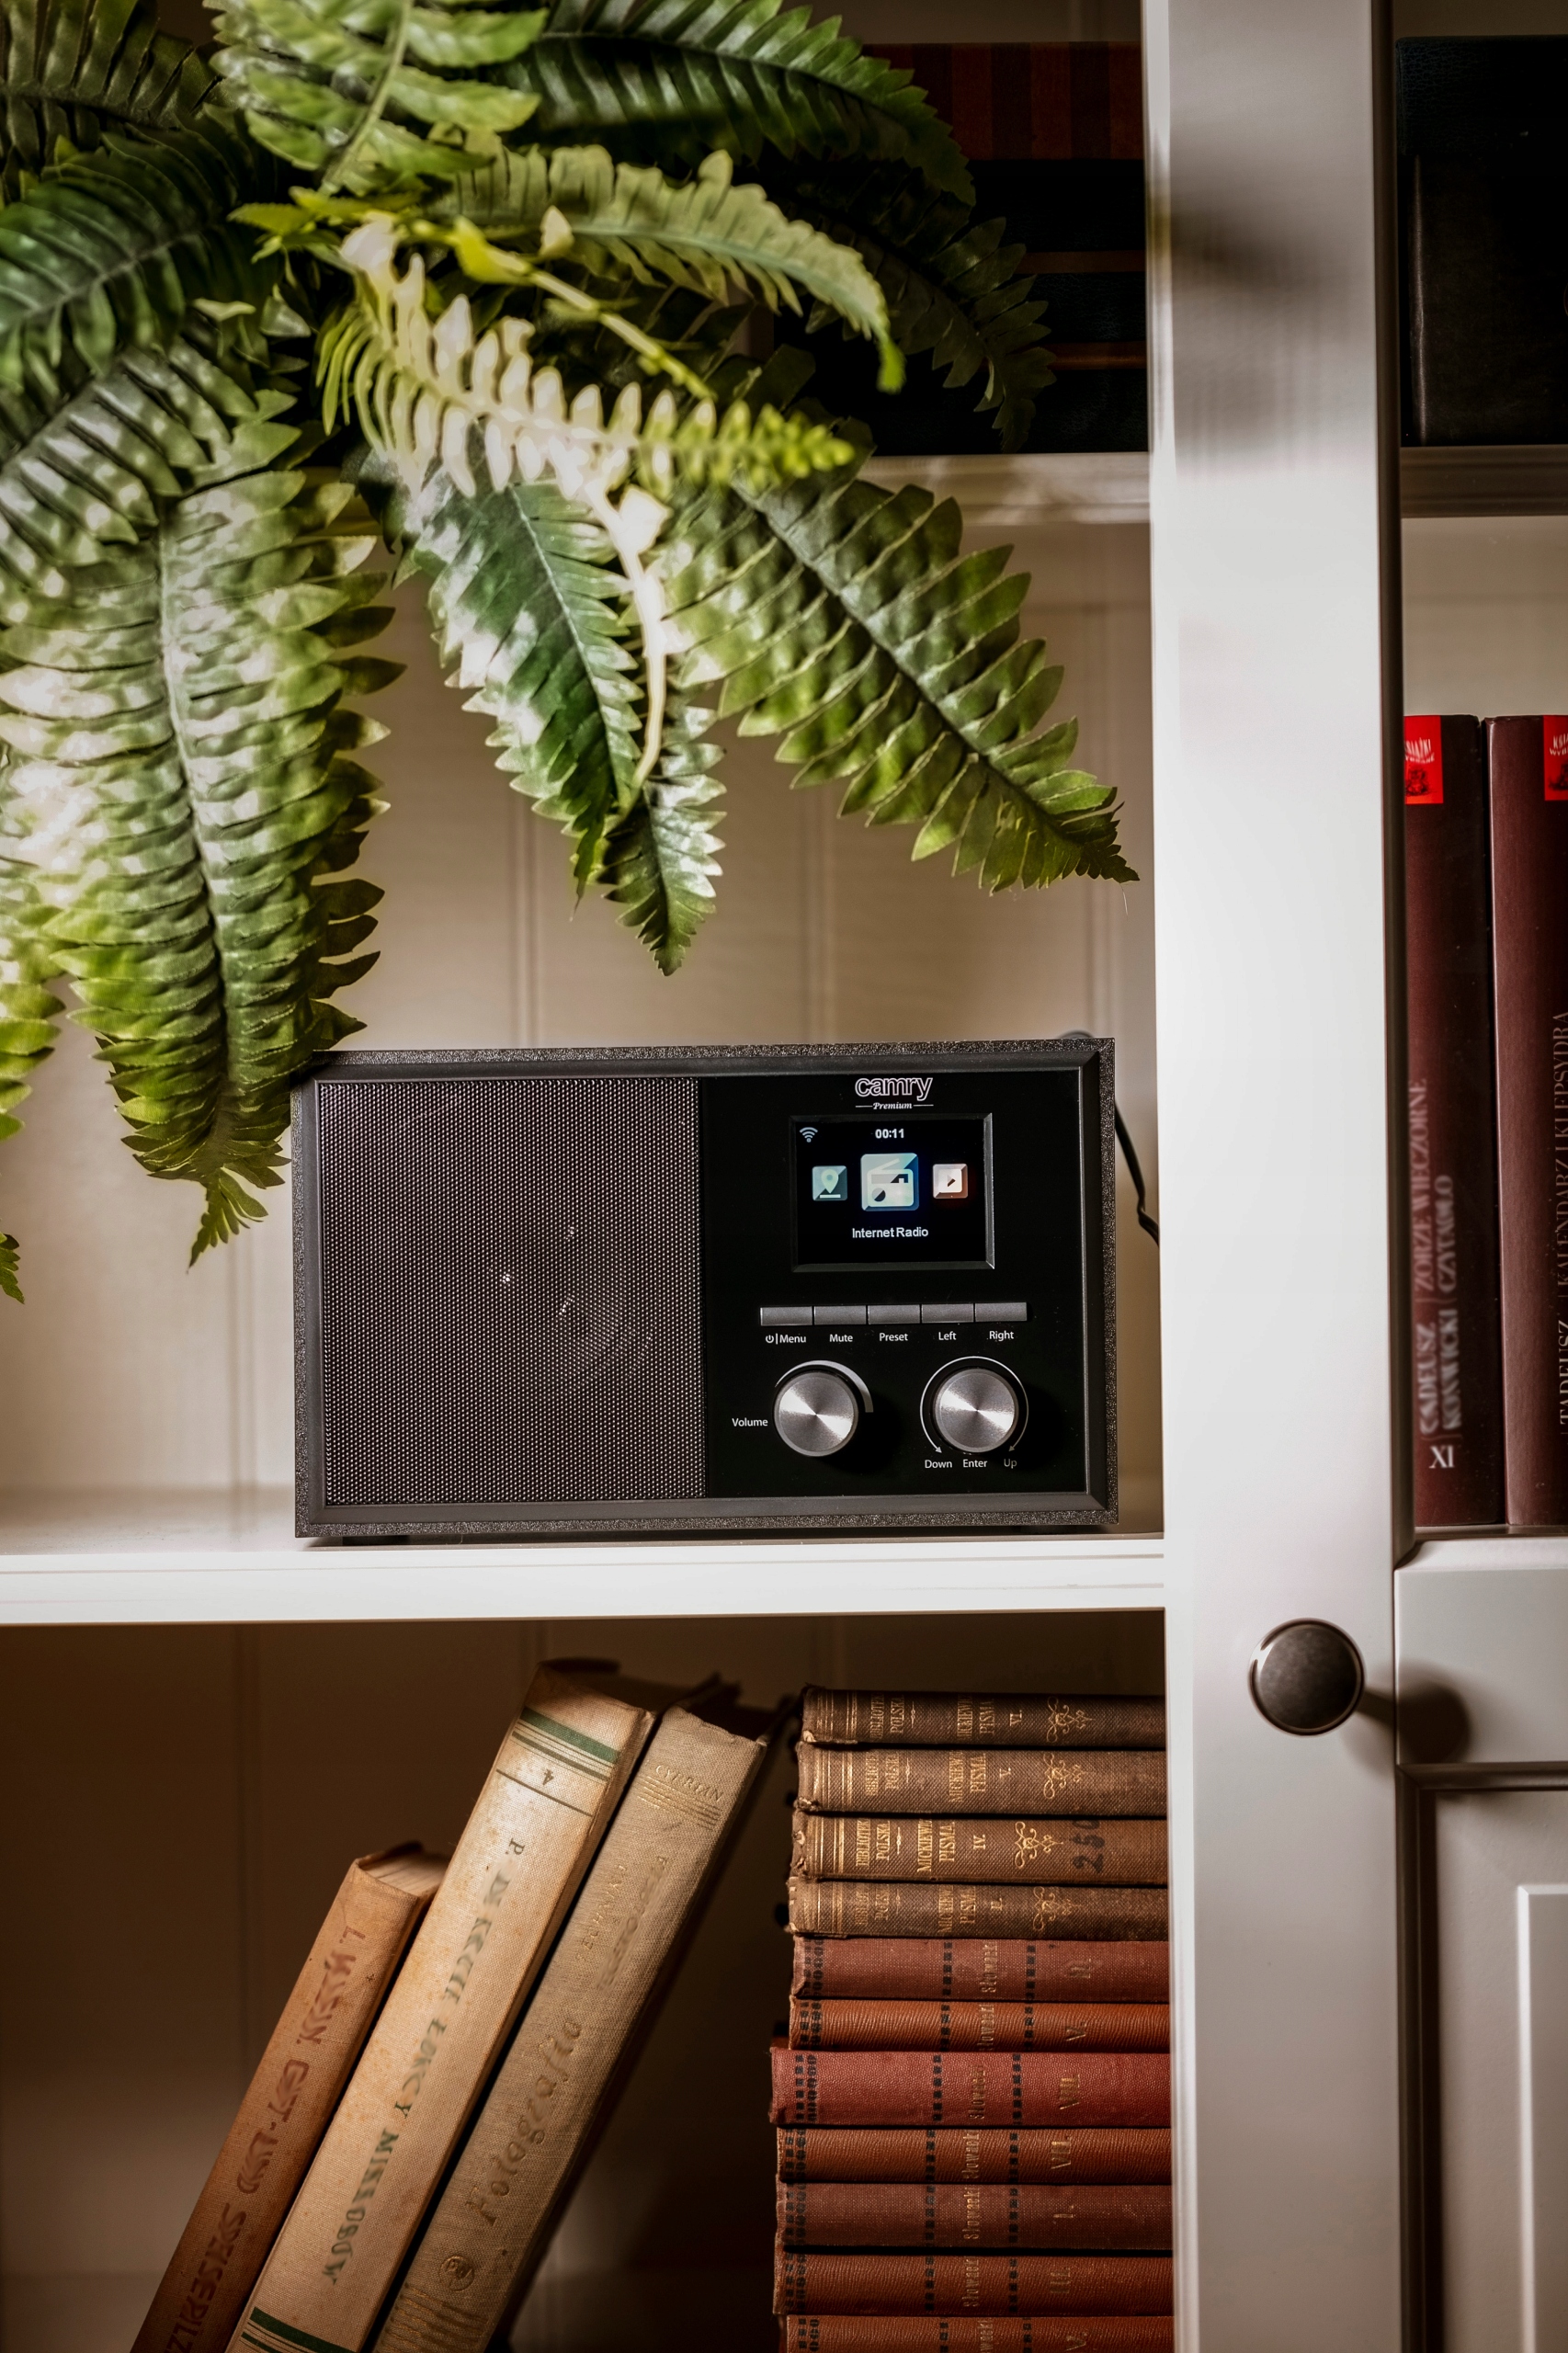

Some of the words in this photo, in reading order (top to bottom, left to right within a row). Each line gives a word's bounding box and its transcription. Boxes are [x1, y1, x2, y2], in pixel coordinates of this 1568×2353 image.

[1549, 746, 1568, 756] WYB
[856, 1076, 933, 1101] camry
[872, 1101, 913, 1110] Premium
[875, 1128, 904, 1140] 00:11
[852, 1226, 894, 1239] Internet
[896, 1225, 928, 1238] Radio
[829, 1333, 853, 1343] Mute
[879, 1332, 909, 1343] Preset
[937, 1331, 957, 1342] Left
[989, 1330, 1015, 1342] Right
[732, 1416, 768, 1428] Volume
[962, 1458, 988, 1469] Enter
[1427, 1446, 1455, 1469] XI
[925, 1459, 953, 1470] Down
[1004, 1458, 1017, 1471] Up
[505, 1838, 525, 1856] P.
[972, 1834, 986, 1850] IV.
[338, 1926, 366, 1944] L.
